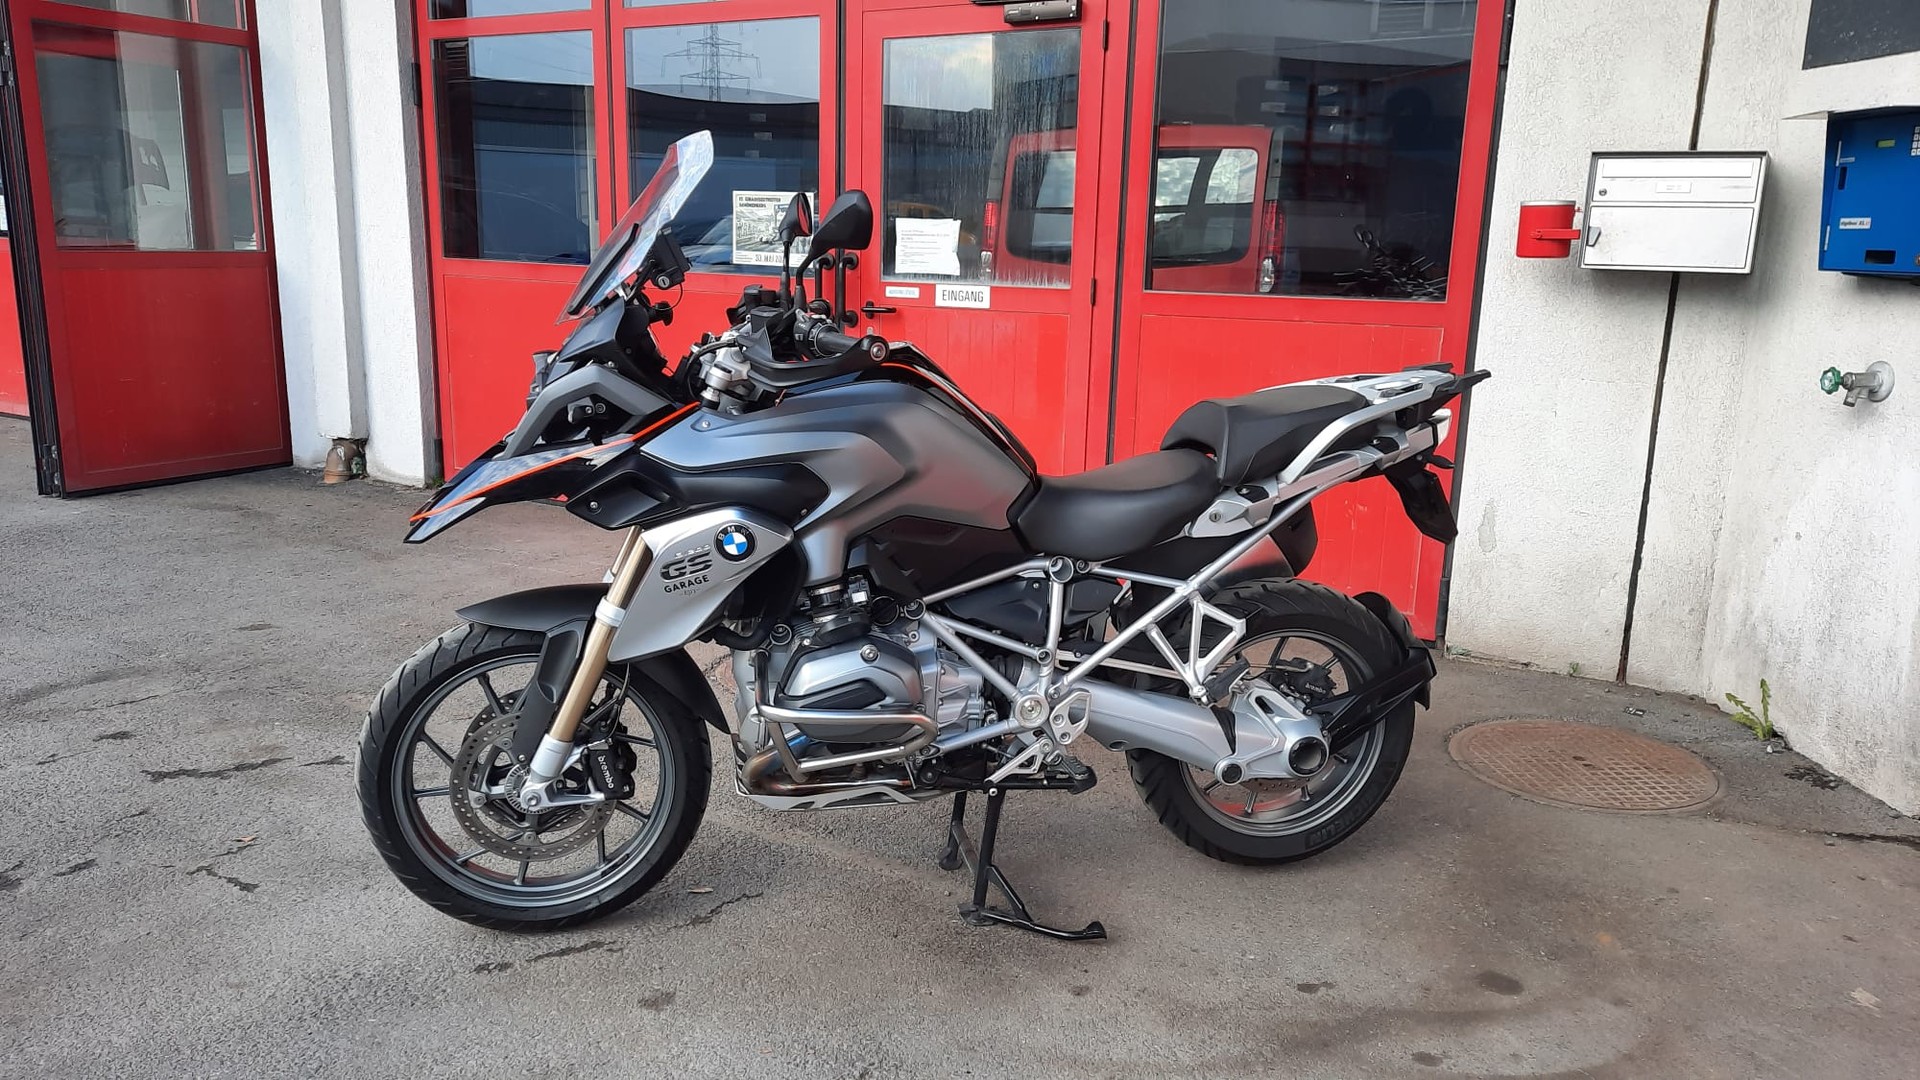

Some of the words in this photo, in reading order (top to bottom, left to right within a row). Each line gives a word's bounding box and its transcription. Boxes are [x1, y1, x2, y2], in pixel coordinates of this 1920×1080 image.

[942, 289, 984, 303] EINGANG
[717, 526, 750, 541] BMW
[661, 552, 713, 581] GS
[664, 574, 710, 594] GARAGE
[597, 755, 614, 789] brembo
